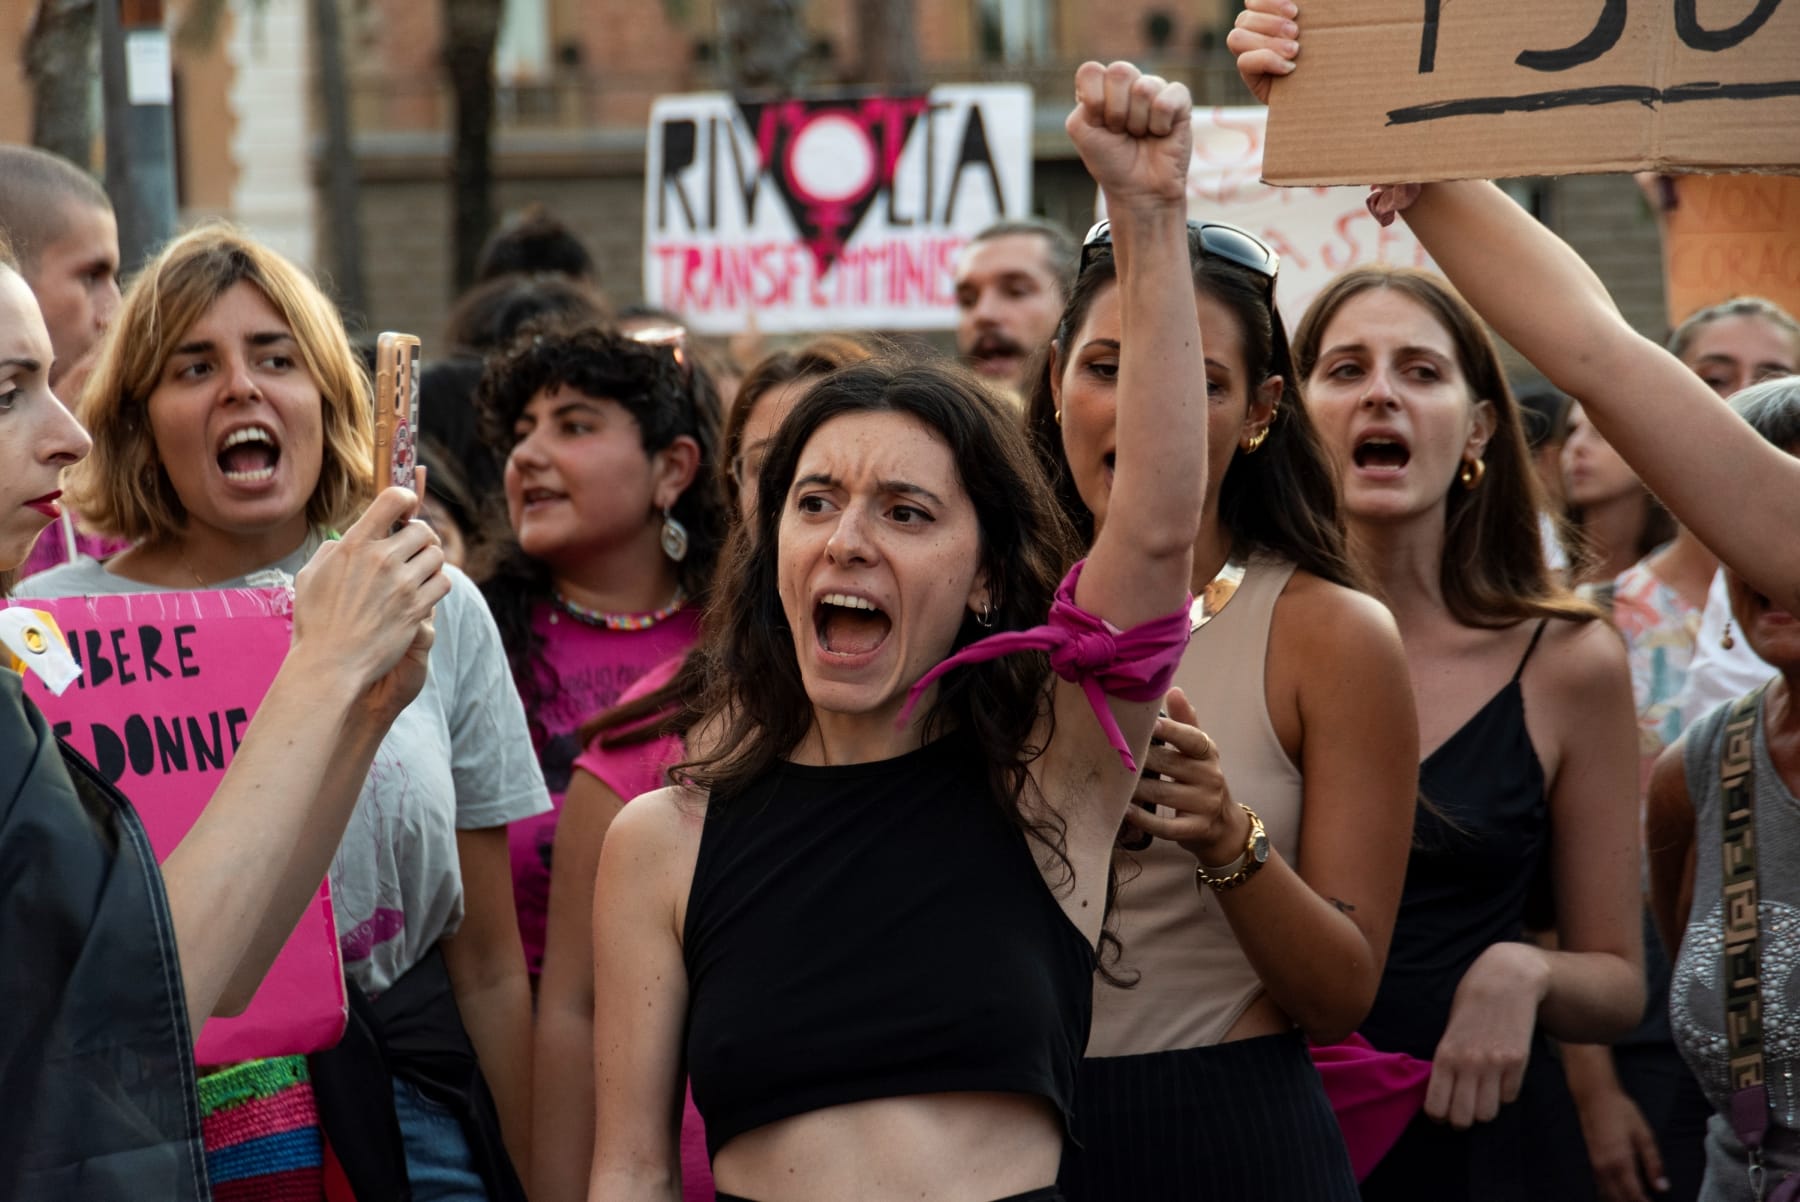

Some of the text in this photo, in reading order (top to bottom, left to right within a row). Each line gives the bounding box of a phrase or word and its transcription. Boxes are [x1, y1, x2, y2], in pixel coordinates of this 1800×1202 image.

[659, 97, 1005, 229] RIVOLTA
[654, 238, 966, 310] TRANSFEMMINIS
[44, 625, 200, 690] IBERE
